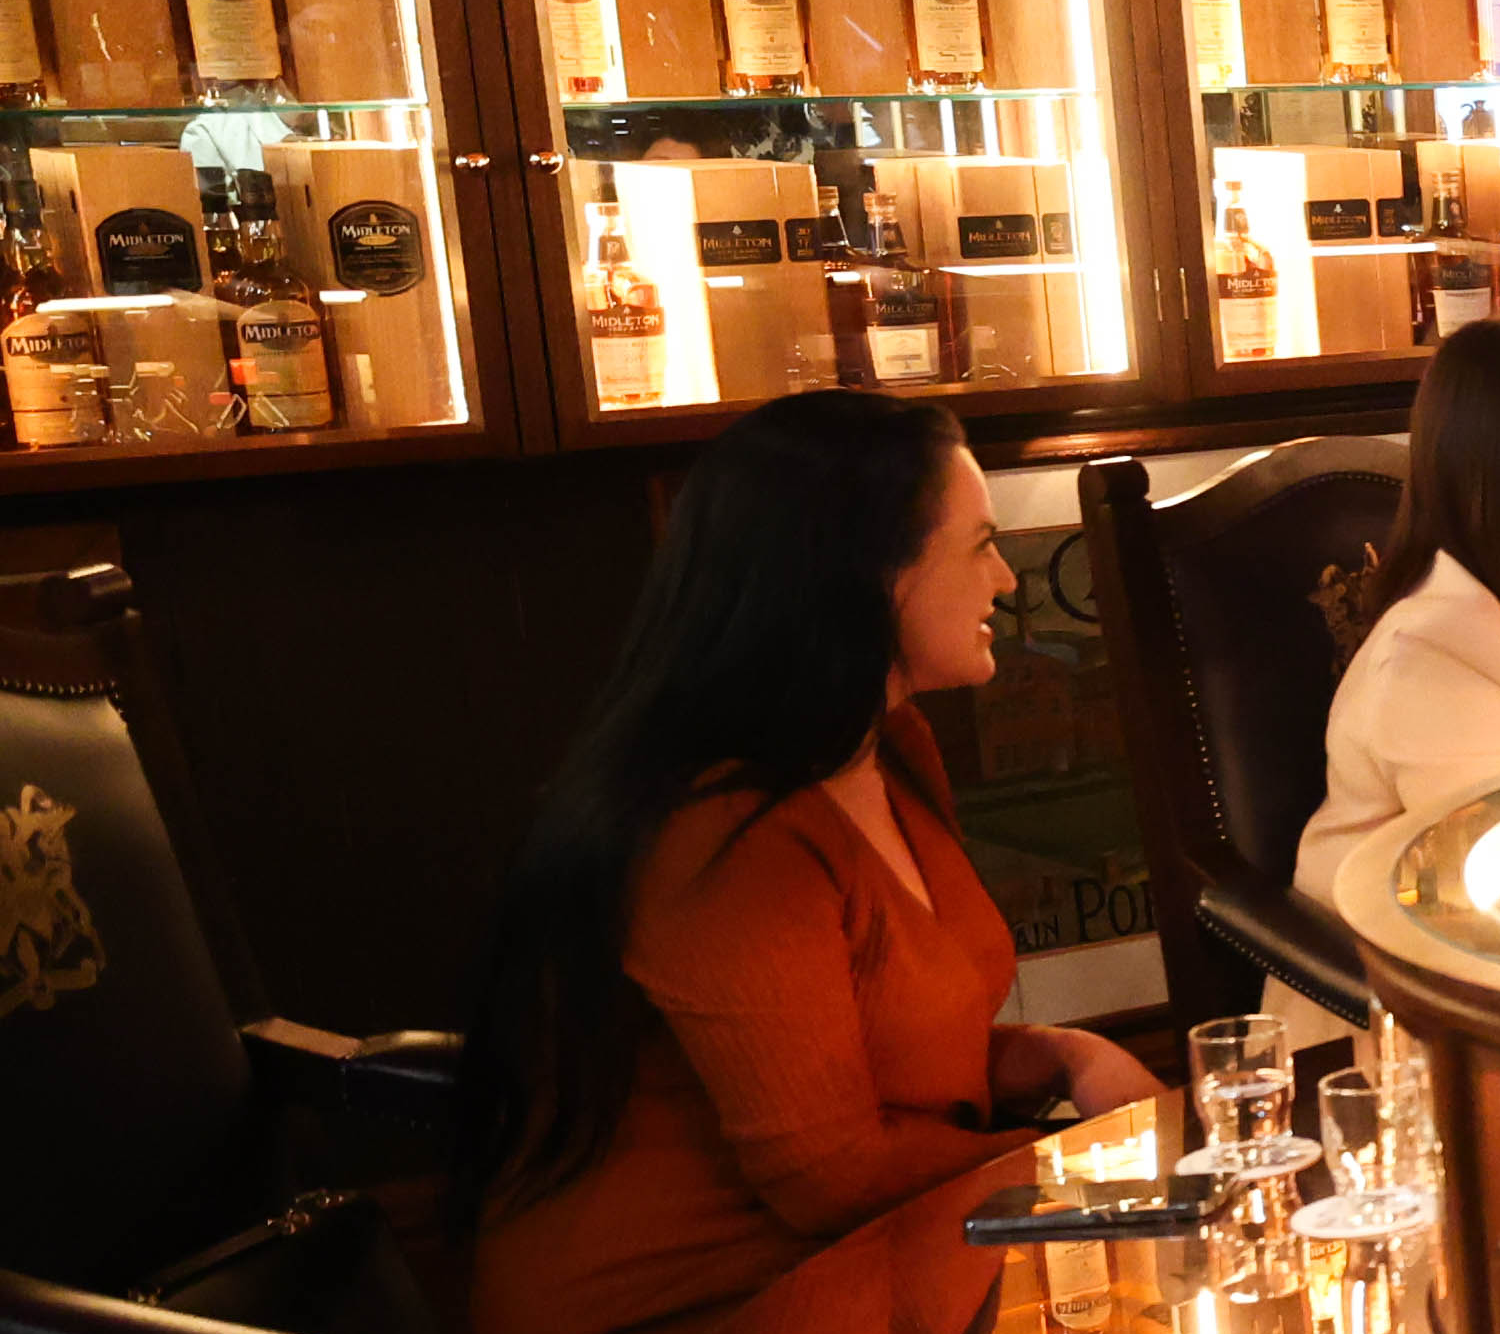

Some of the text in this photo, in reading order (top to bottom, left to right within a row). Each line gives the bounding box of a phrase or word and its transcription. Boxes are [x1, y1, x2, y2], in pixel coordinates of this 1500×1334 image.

[1312, 214, 1368, 226] MIDLETON
[340, 223, 411, 239] MIDLETON
[108, 232, 185, 248] MIDLETON
[703, 236, 772, 251] MIDLETON
[592, 314, 660, 328] MIDLETON
[244, 324, 319, 343] MIDLETO
[9, 337, 86, 355] MIDLETO
